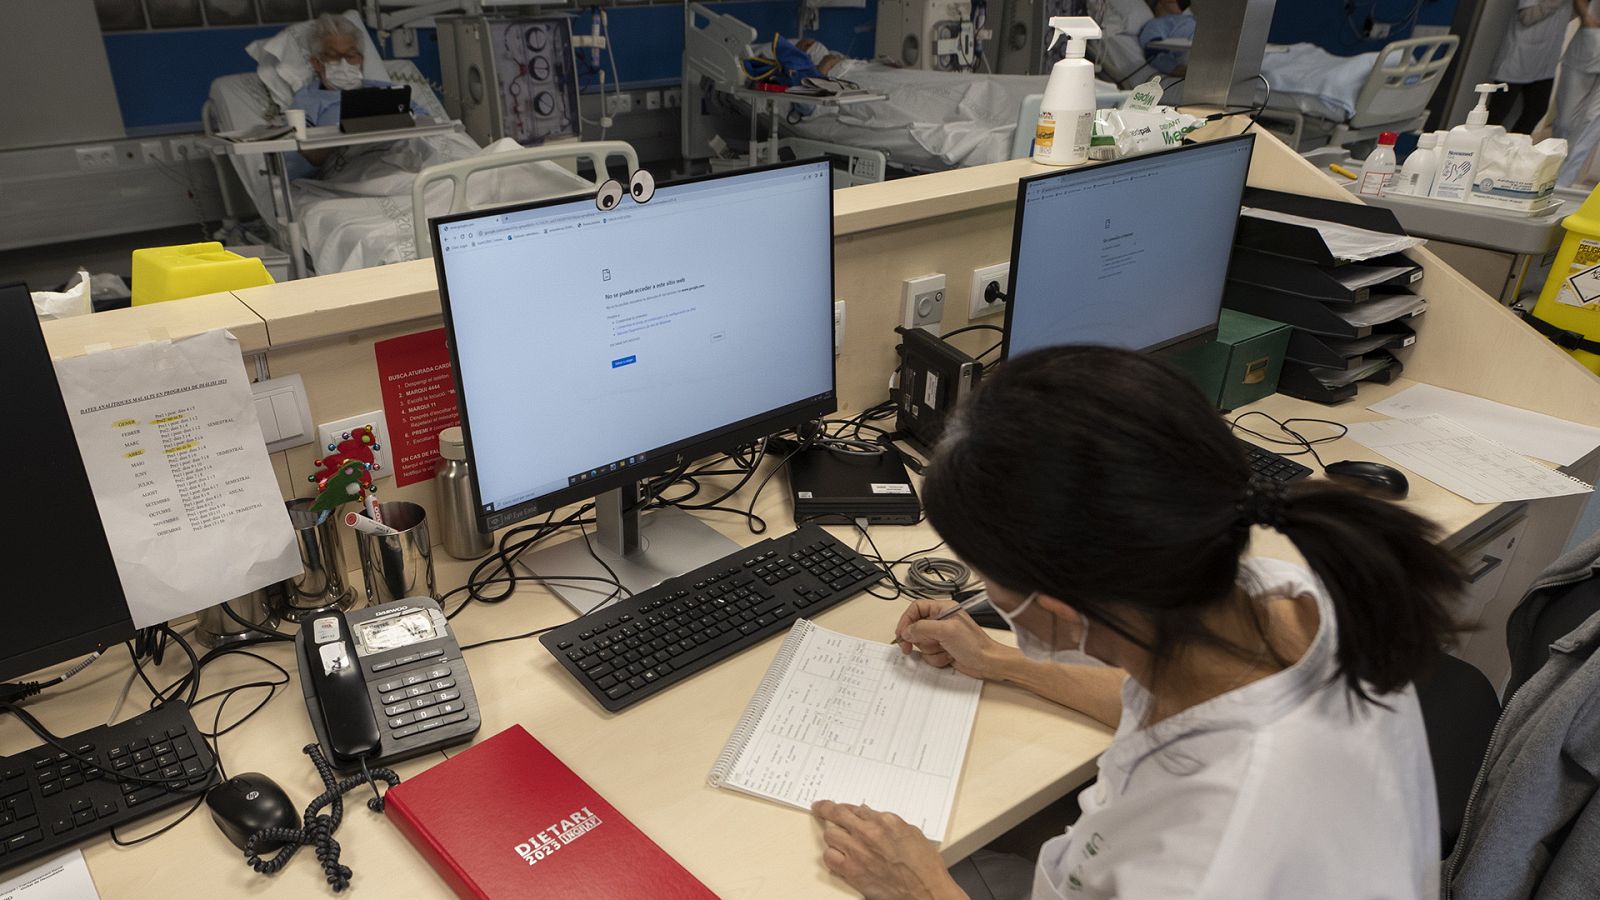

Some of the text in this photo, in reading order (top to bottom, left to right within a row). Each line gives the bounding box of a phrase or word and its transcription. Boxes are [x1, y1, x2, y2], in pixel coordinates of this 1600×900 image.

[620, 289, 633, 298] puede
[388, 372, 407, 381] BUSCA
[408, 366, 434, 377] ATURADA
[406, 388, 428, 396] MARQUI
[409, 405, 430, 413] MARQUI
[410, 452, 421, 460] CAS
[375, 606, 408, 616] DAEWOO
[514, 806, 594, 856] DIETARI
[525, 841, 561, 865] 2023
